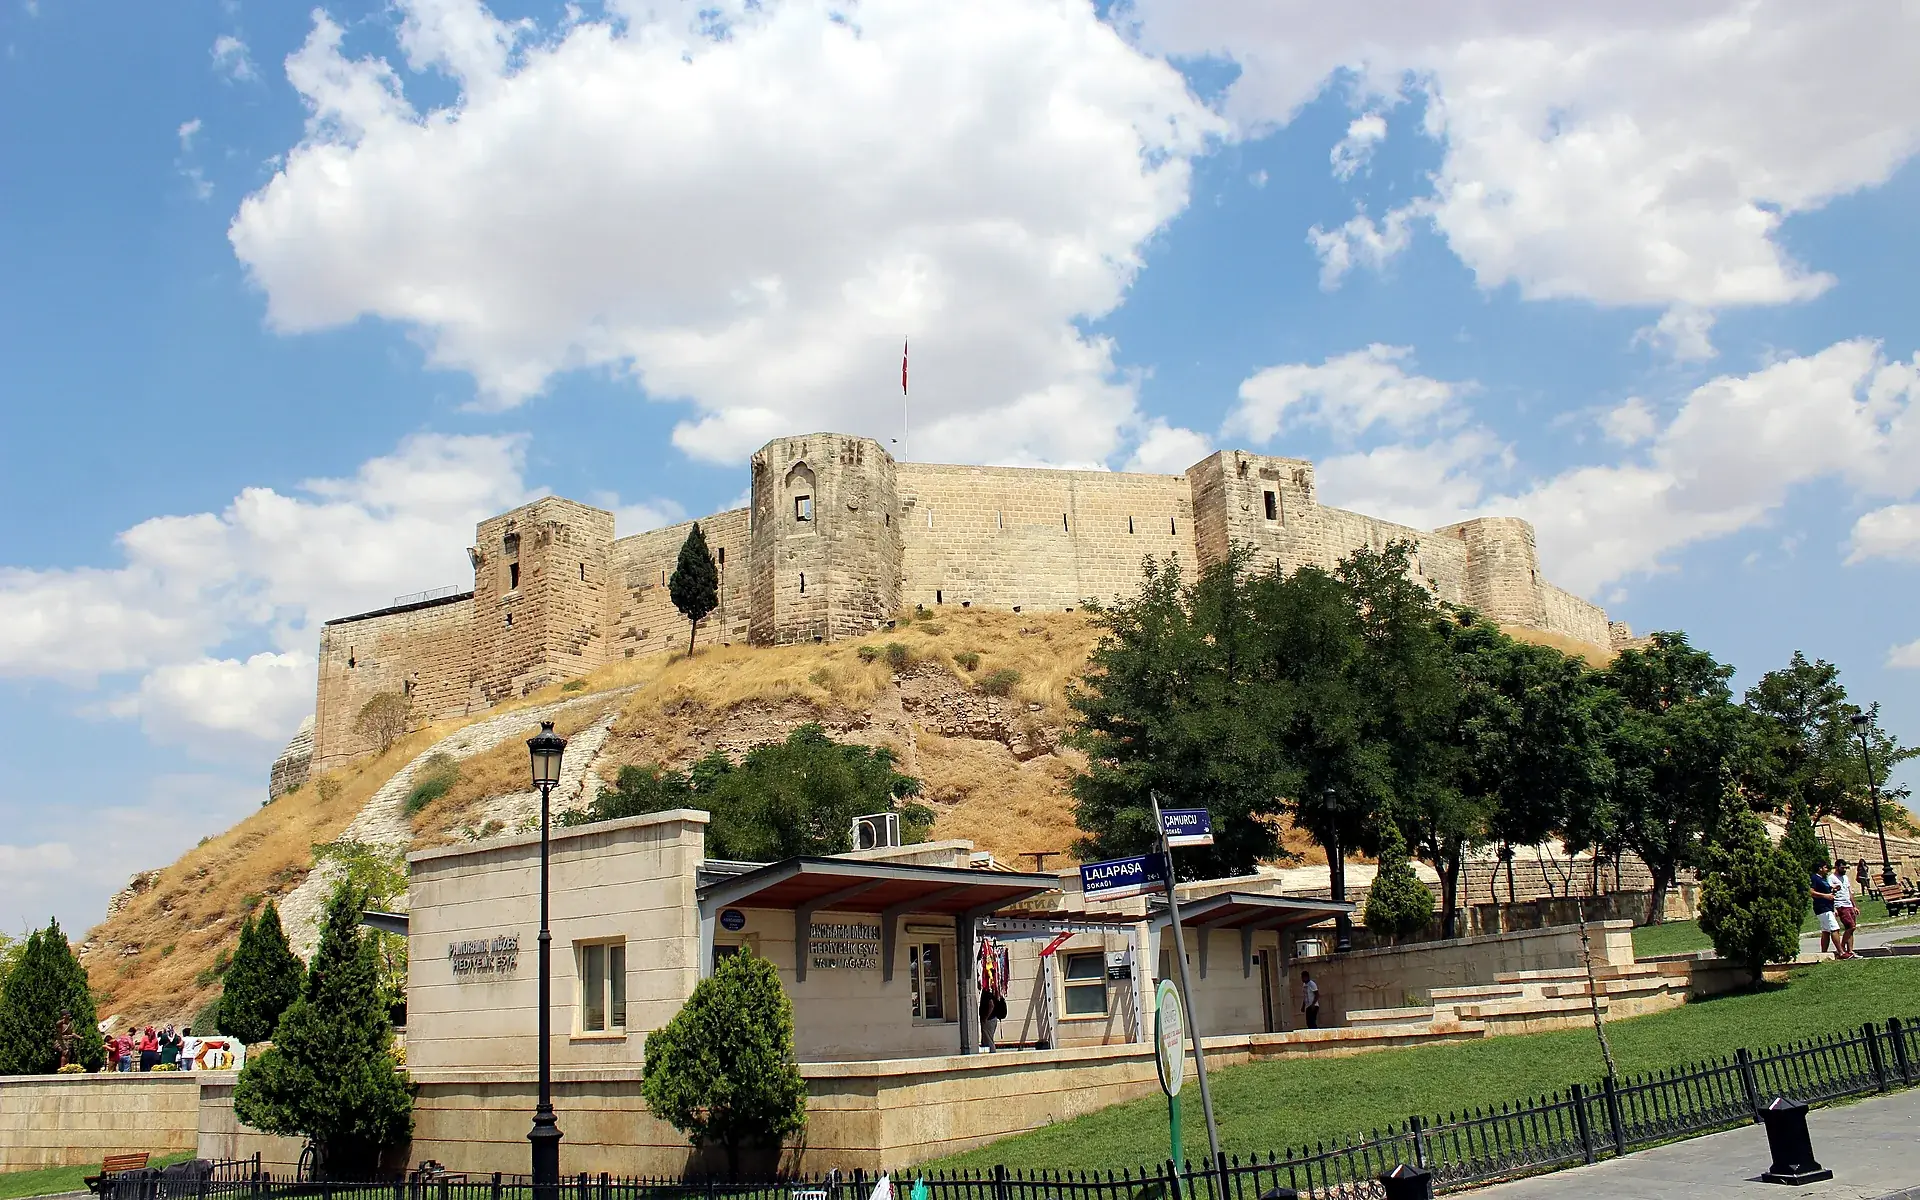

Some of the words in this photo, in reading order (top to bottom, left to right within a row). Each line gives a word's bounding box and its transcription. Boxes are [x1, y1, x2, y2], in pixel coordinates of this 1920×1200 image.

[1164, 814, 1198, 827] ÇAMURCU
[1085, 862, 1143, 880] LALAPAŞA
[1086, 880, 1112, 890] SOKAĞI
[809, 940, 856, 955] HEDİYELİK
[857, 942, 879, 957] EŞYA
